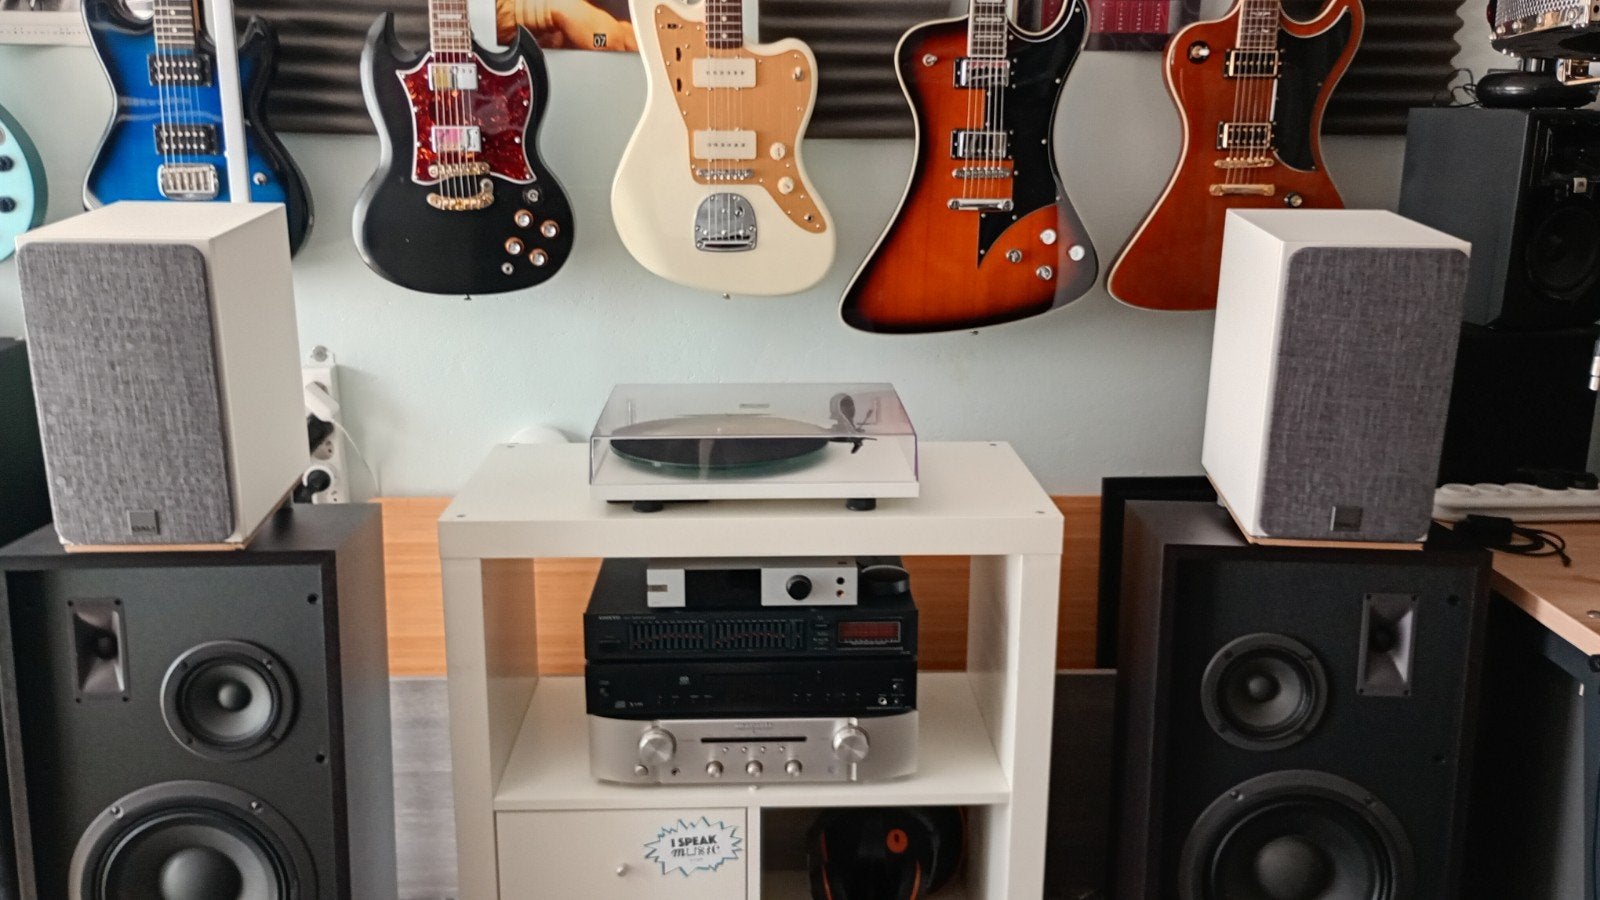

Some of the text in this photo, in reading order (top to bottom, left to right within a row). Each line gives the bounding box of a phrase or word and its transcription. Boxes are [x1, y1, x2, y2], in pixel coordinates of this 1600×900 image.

[594, 33, 606, 47] 07
[671, 835, 717, 847] I SPEAK
